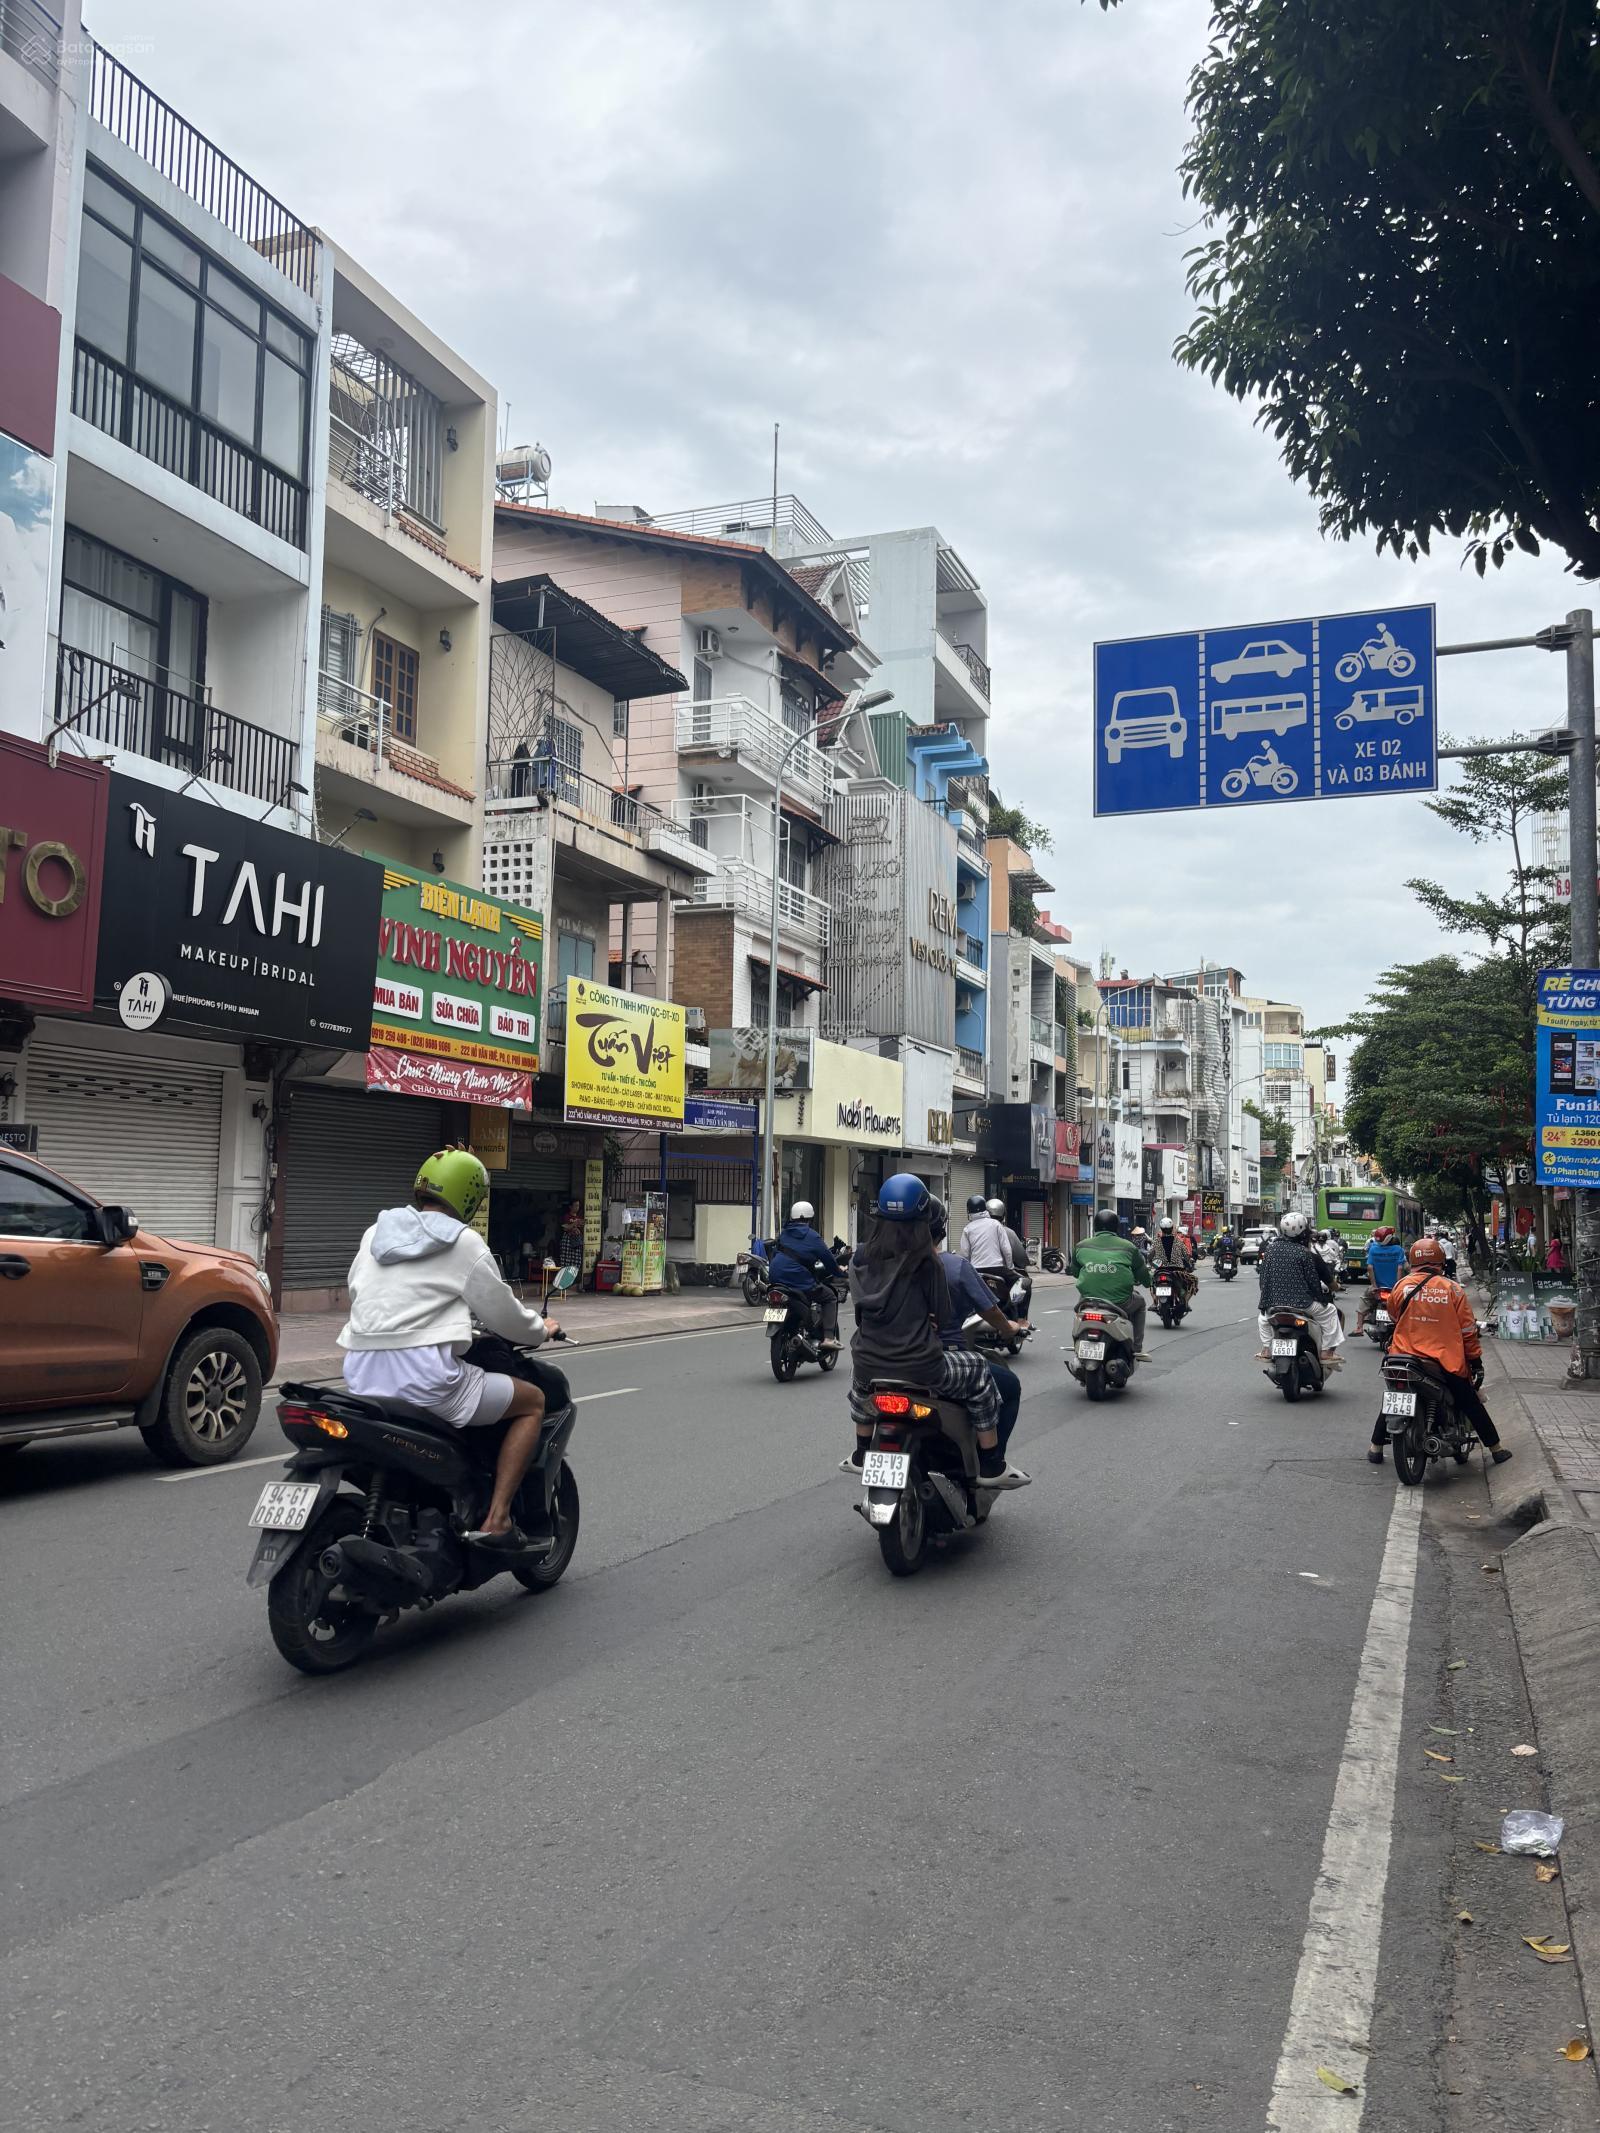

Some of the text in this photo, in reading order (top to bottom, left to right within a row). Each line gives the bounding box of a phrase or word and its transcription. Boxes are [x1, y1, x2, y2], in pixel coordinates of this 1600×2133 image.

[1354, 739, 1402, 759] XE 02
[1327, 758, 1427, 785] VÀ 03 BÁNH
[182, 843, 325, 948] TAHI
[421, 882, 501, 934] ĐIỆN LẠNH
[180, 943, 316, 987] MAKEUP BRIDAL
[128, 998, 157, 1014] TAHI
[373, 986, 419, 1013] MUA BÁN
[589, 989, 610, 1005] CÔNG
[610, 996, 619, 1008] TY
[619, 998, 637, 1013] TNHH
[1547, 993, 1597, 1010] TỪNG
[436, 997, 480, 1026] SỬA CHỮA
[497, 1011, 530, 1037] BẢO TRÌ
[1221, 1018, 1232, 1080] WEDDING
[396, 1054, 426, 1079] Chúc
[863, 1105, 901, 1136] Flowers
[1546, 1112, 1560, 1123] Tủ
[1561, 1113, 1582, 1126] lạnh
[1543, 1166, 1557, 1175] 179
[1557, 1167, 1578, 1176] Phan
[1085, 1261, 1118, 1274] Grab
[1421, 1293, 1449, 1304] Food
[1385, 1400, 1412, 1416] 7649
[869, 1453, 904, 1471] 59-V3
[864, 1469, 905, 1487] 554.13
[267, 1485, 309, 1506] 94-G1
[254, 1505, 306, 1526] 068.86
